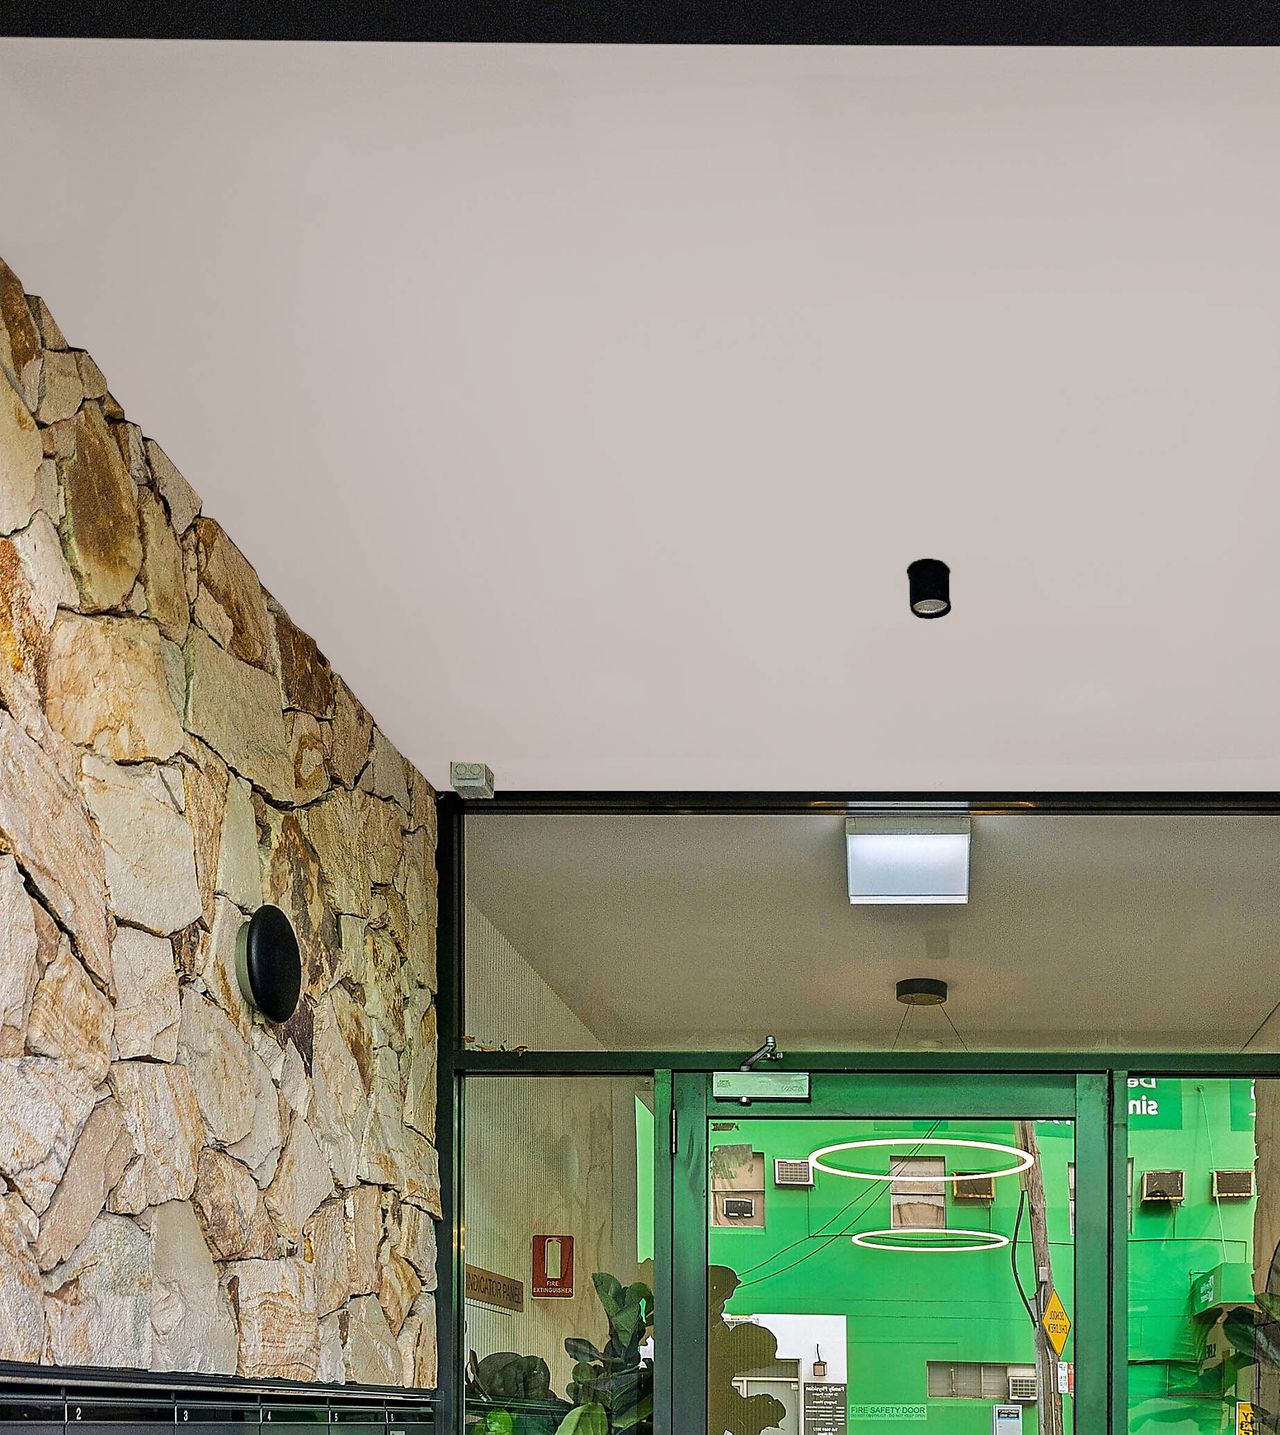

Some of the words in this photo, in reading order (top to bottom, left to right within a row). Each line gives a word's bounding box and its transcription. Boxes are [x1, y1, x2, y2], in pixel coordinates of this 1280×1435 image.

[502, 1283, 522, 1304] PANEL
[76, 1408, 82, 1421] 2
[183, 1410, 189, 1421] 3
[850, 1406, 868, 1414] FIRE
[869, 1406, 901, 1414] SAFETY
[901, 1406, 926, 1414] DOOR
[267, 1411, 271, 1421] 4
